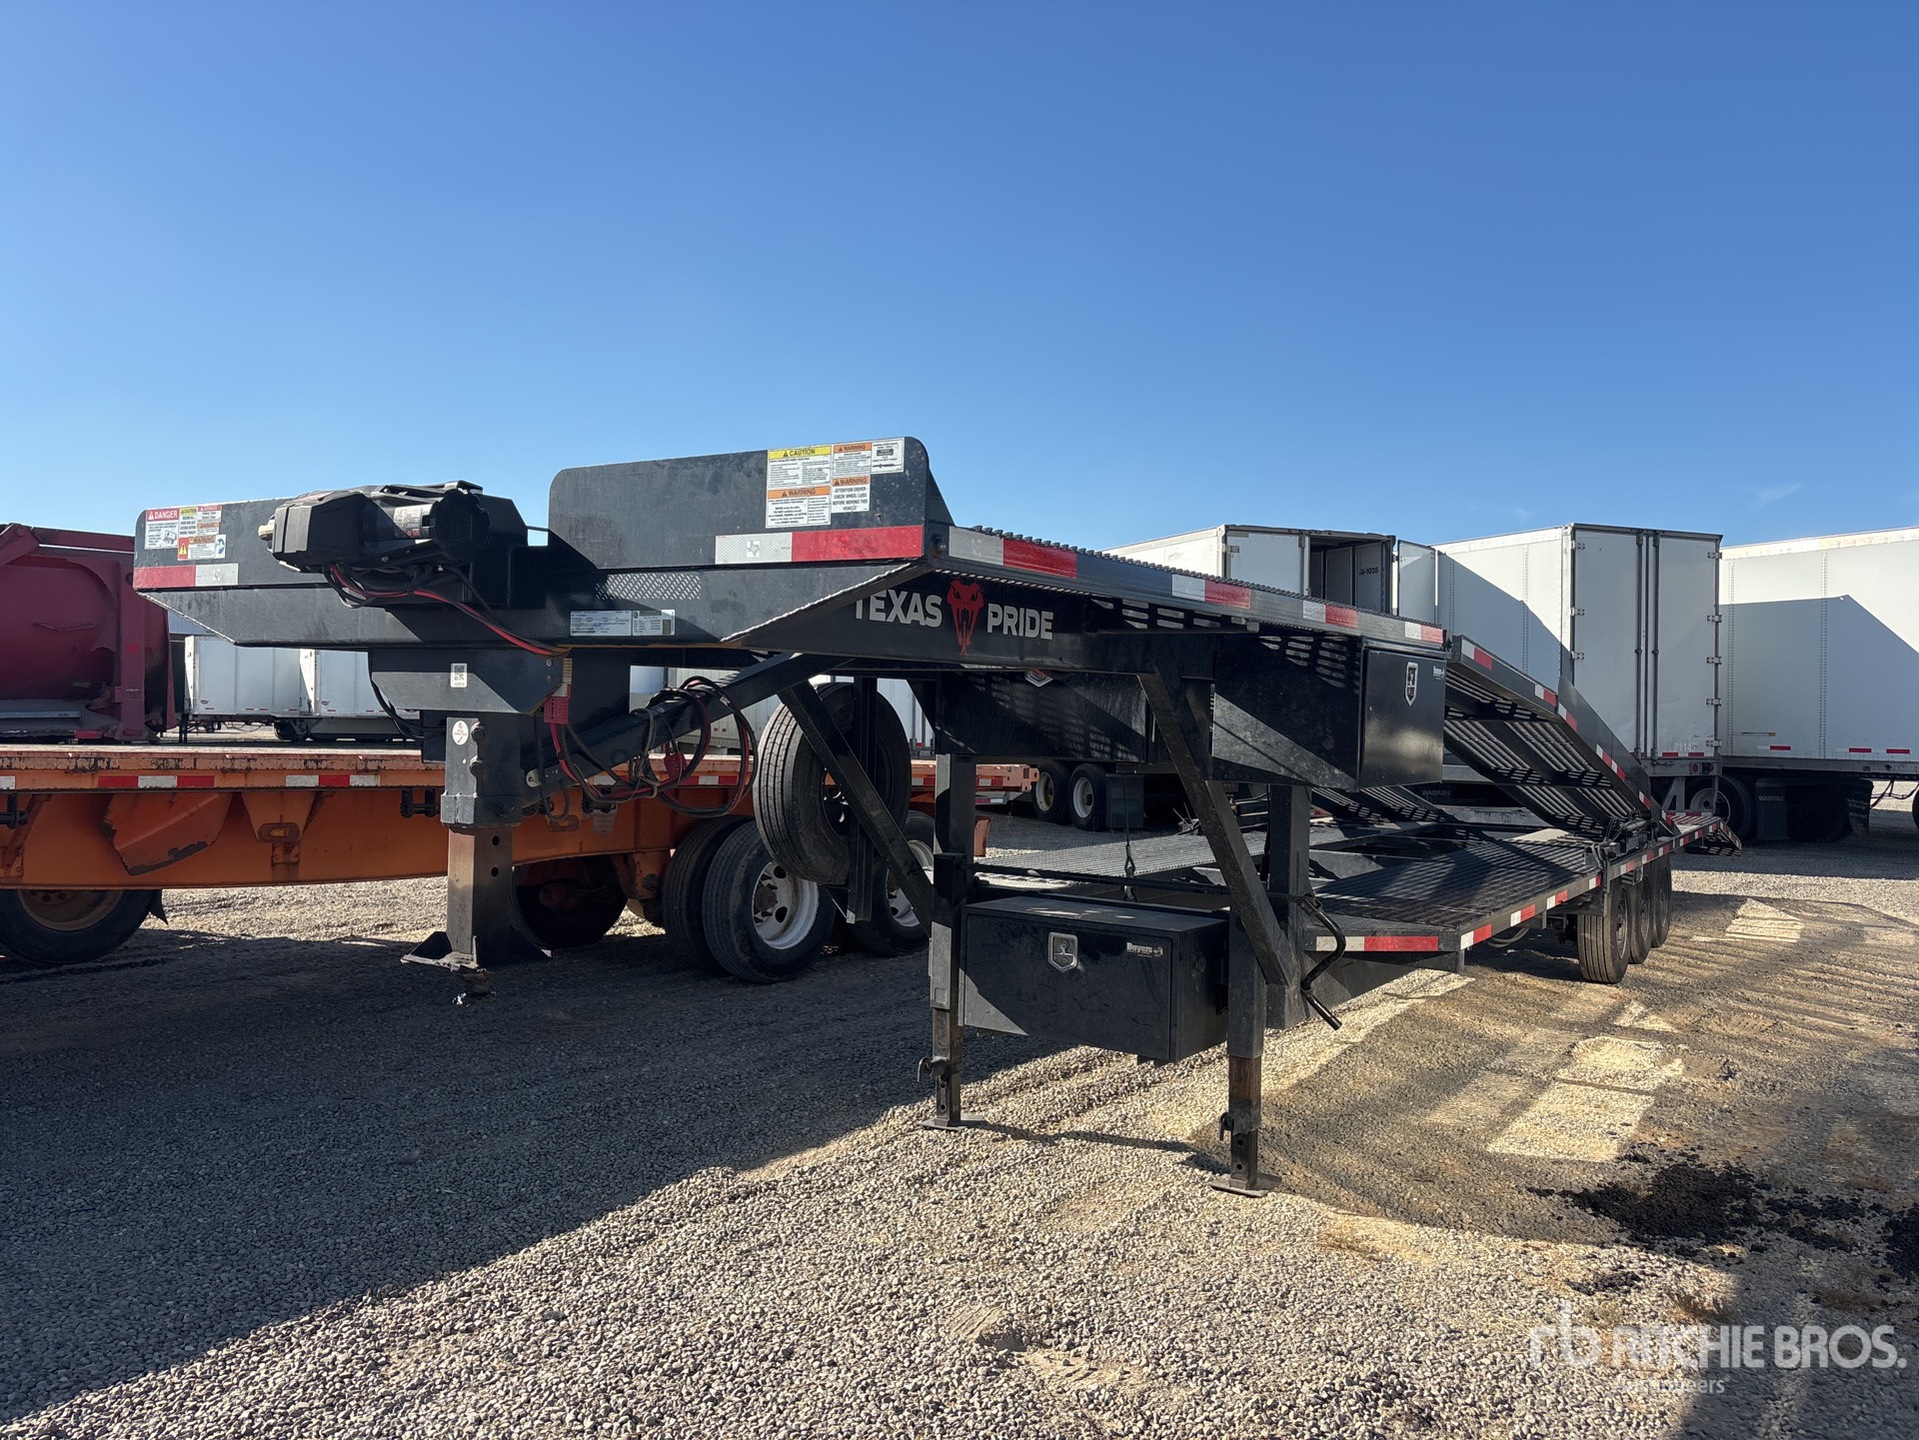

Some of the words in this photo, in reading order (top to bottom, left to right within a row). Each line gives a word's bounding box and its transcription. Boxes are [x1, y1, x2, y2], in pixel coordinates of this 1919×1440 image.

[789, 448, 816, 457] CAUTION
[788, 488, 816, 497] WARNING
[154, 510, 178, 520] DANGER
[987, 603, 1054, 640] PRIDE
